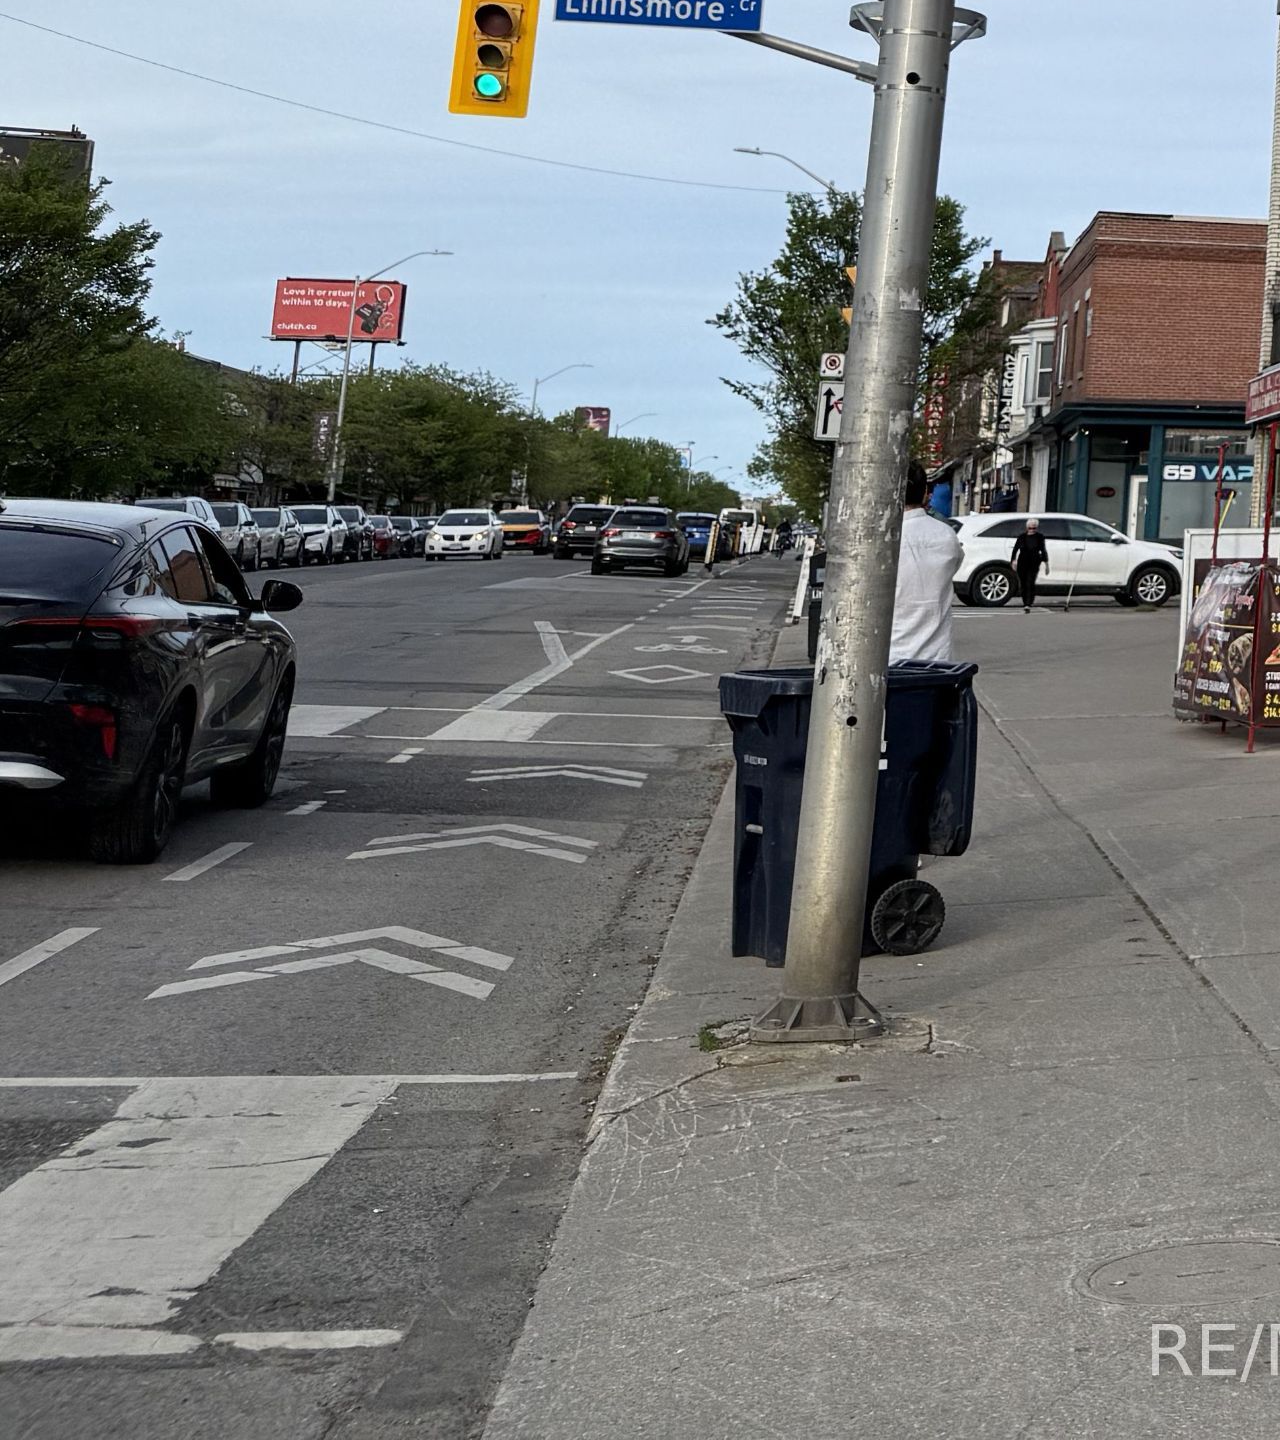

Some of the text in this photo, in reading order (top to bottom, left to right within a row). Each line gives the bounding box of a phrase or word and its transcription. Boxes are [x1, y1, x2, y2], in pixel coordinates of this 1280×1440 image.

[283, 288, 305, 296] Love
[307, 288, 315, 296] it
[328, 289, 354, 298] return
[359, 290, 365, 298] it
[282, 298, 349, 308] within 10 days.
[1163, 464, 1254, 480] 69 VAP
[1271, 613, 1276, 621] 2
